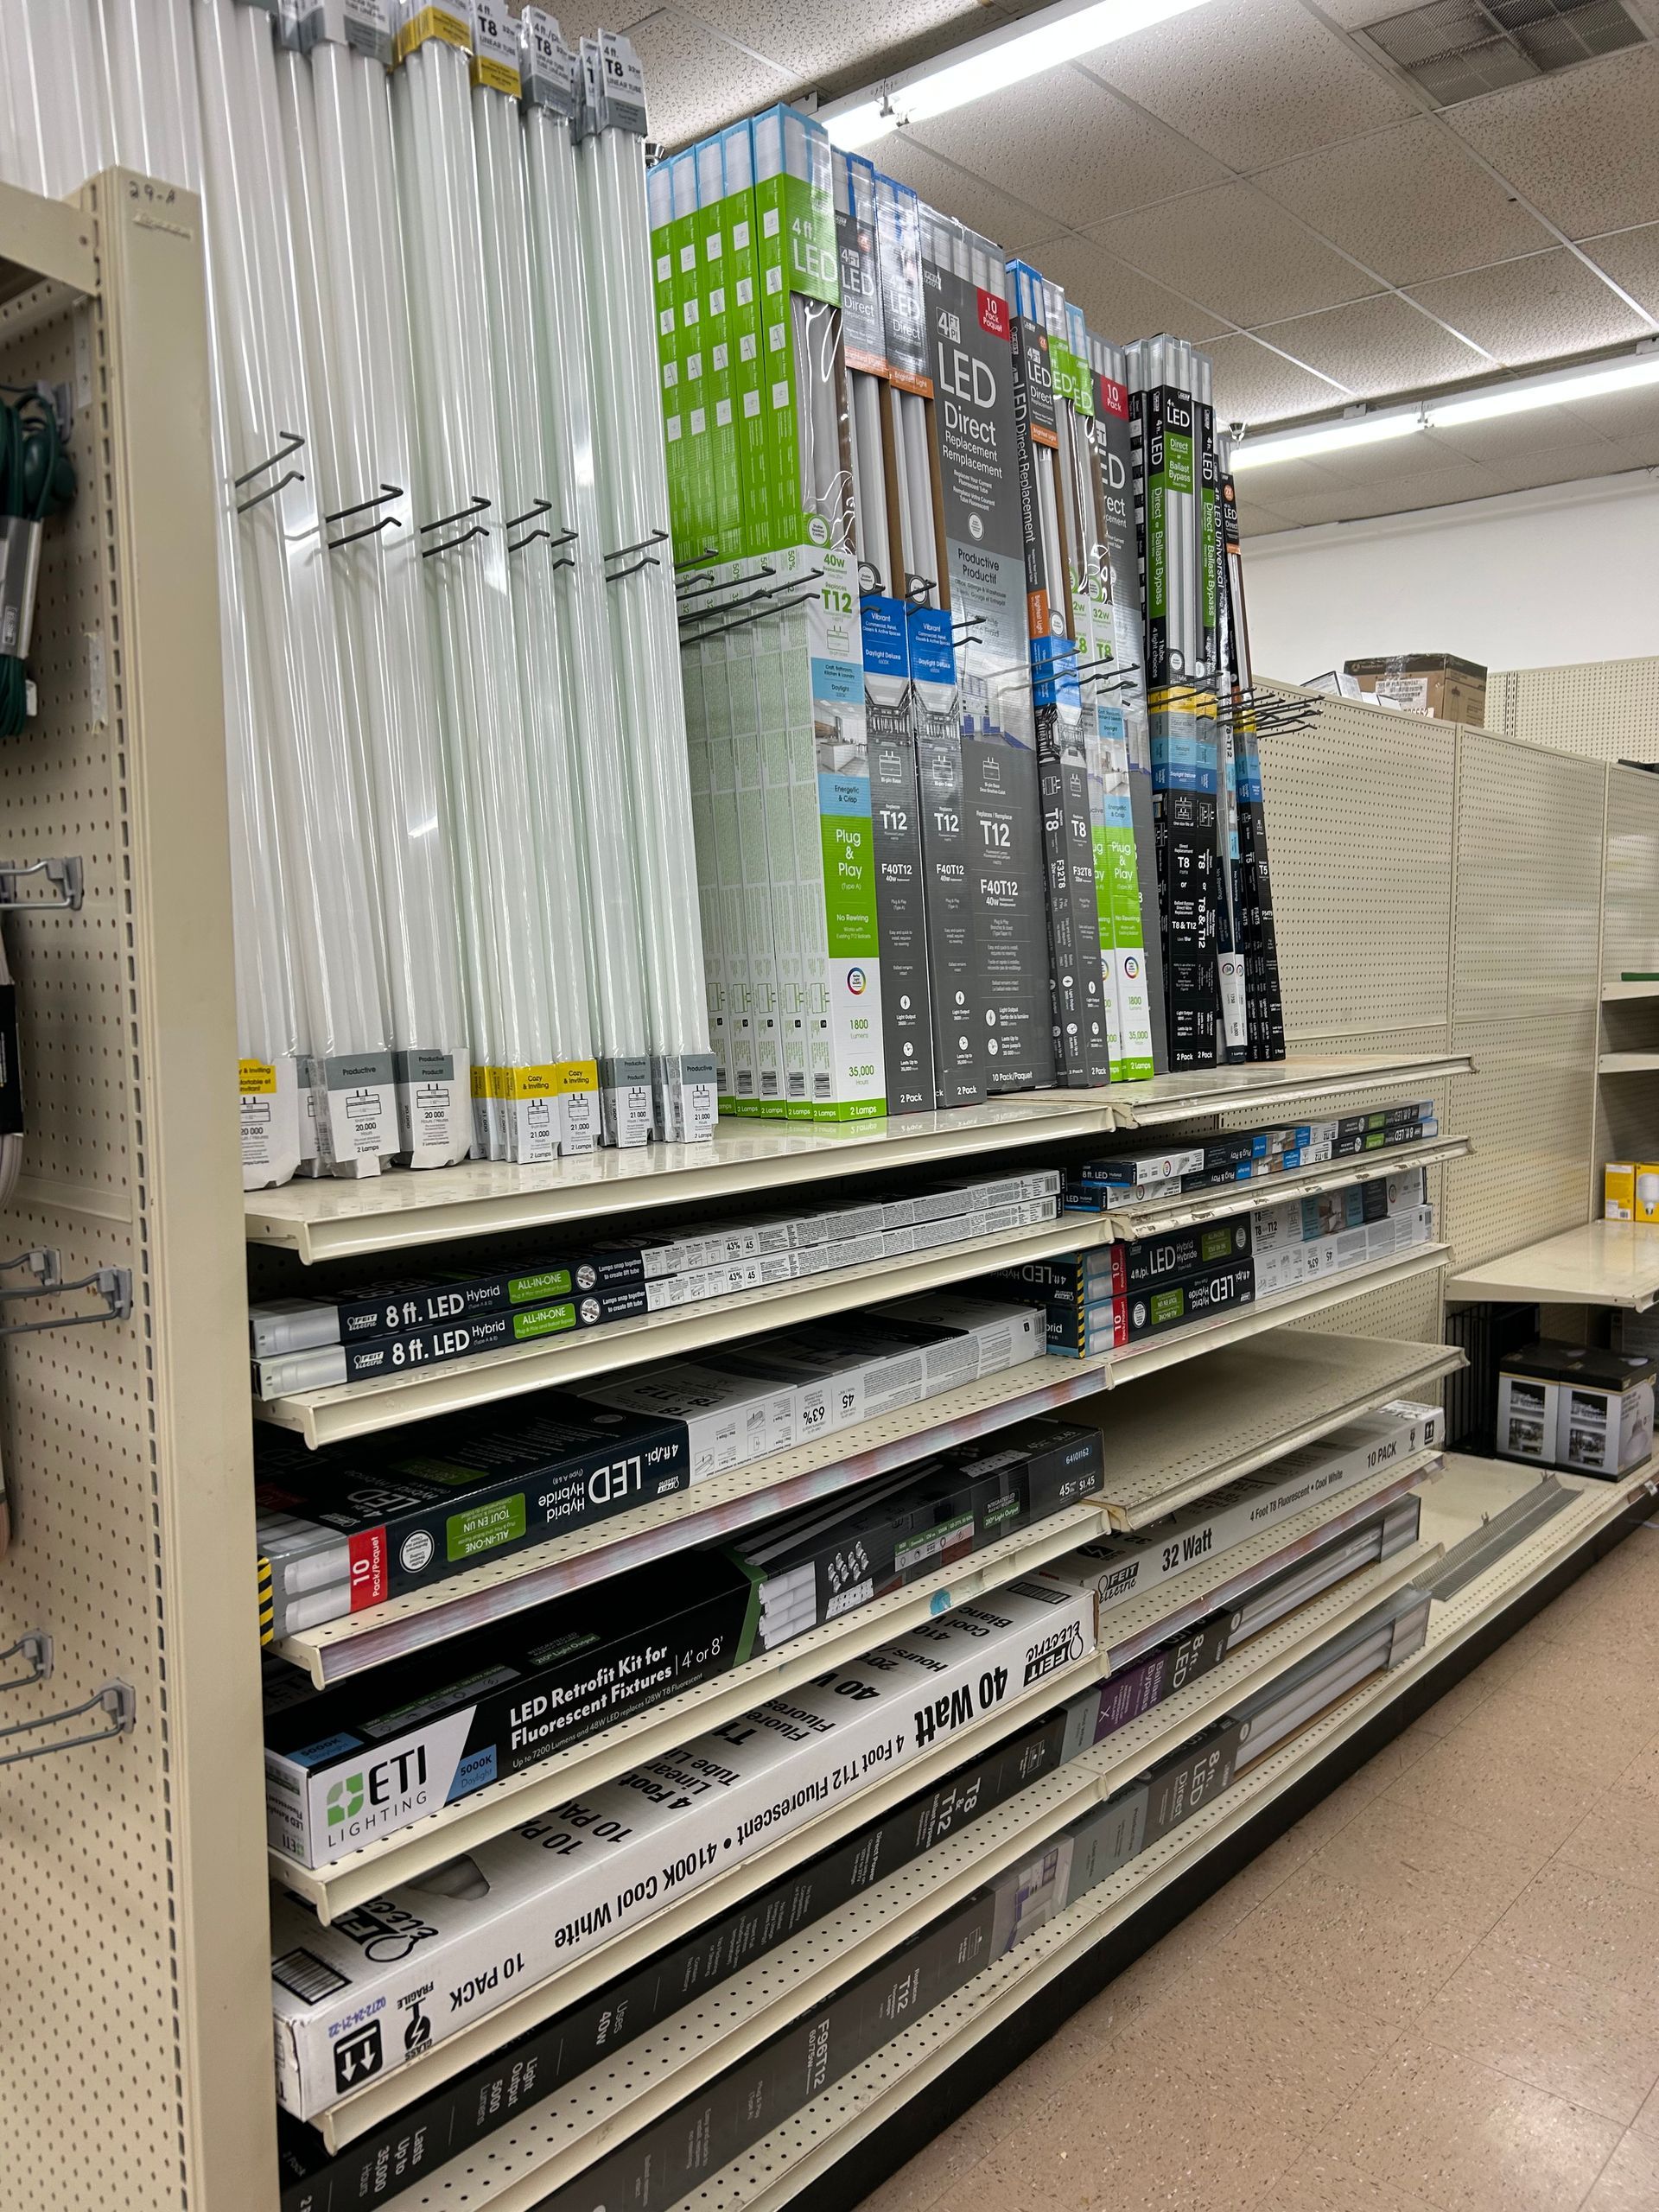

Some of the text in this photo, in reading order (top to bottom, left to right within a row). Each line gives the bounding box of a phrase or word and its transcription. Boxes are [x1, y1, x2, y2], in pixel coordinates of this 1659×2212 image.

[606, 59, 623, 77] T8
[793, 238, 838, 282] LED
[842, 265, 874, 297] LED
[844, 296, 875, 318] Direct
[986, 297, 997, 314] 10
[893, 318, 920, 340] Direct
[938, 341, 995, 409] LED
[1027, 361, 1052, 389] LED
[1107, 384, 1118, 401] 10
[1107, 397, 1122, 412] Pack
[944, 401, 996, 446] Direct
[1166, 407, 1190, 429] LED
[945, 430, 998, 462] Replacement
[943, 445, 1003, 479] Remplacement
[1013, 382, 1036, 543] LED Direct Replacement
[1169, 461, 1190, 474] Ballast
[1169, 470, 1191, 483] Bypass
[823, 553, 845, 568] 40w
[957, 548, 1000, 571] Productive
[1215, 531, 1224, 588] Universal
[963, 564, 997, 584] Productif
[821, 588, 852, 613] T12
[871, 612, 891, 622] Vibrant
[880, 810, 907, 830] T12
[934, 812, 959, 831] T12
[1045, 808, 1059, 831] T8
[1071, 820, 1087, 837] T8
[836, 830, 861, 847] Plug
[979, 820, 1011, 848] T12
[1111, 841, 1131, 855] Plug
[838, 862, 862, 879] Play
[881, 864, 912, 875] F40T12
[937, 864, 964, 875] F40T12
[1056, 859, 1066, 889] F32T8
[1072, 866, 1092, 876] F32T8
[1114, 868, 1134, 881] Play
[1177, 856, 1190, 868] T8
[980, 879, 1018, 896] F40T12
[849, 1019, 868, 1030] 1800
[1128, 1031, 1148, 1039] 35,000
[342, 1065, 376, 1076] Productive
[849, 1065, 874, 1077] 35,000
[999, 1071, 1033, 1081] Pack/Paquet
[528, 1081, 550, 1090] Inviting
[906, 1093, 922, 1103] Pack
[849, 1106, 877, 1116] 2 Lamps
[727, 1239, 753, 1252] 43% 45
[1177, 1251, 1198, 1262] Hybride
[518, 1274, 563, 1291] ALL-IN-ONE
[1211, 1274, 1234, 1302] LED
[385, 1285, 501, 1328] 8 ft. LED Hybrid
[522, 1307, 566, 1325] ALL-IN-ONE
[392, 1319, 506, 1365] 8 ft. LED Hybrid
[803, 1392, 855, 1427] 63% 45
[538, 1481, 585, 1507] Hybride
[546, 1444, 679, 1523] 4 ft./pi. LED Hybrid
[1079, 1476, 1096, 1491] $1.45
[1161, 1440, 1397, 1573] 32 Watt 4 Foot T8 Fluorescent Cool White 10 PACK
[465, 1529, 509, 1554] ALL-IN-ONE
[353, 1559, 370, 1586] 10
[372, 1535, 380, 1597] Pack/Paquet
[1107, 1561, 1140, 1592] FEIT
[958, 1606, 1014, 1629] Blanc
[1192, 1633, 1205, 1651] 8
[1025, 1641, 1070, 1687] FEIT
[1173, 1639, 1192, 1688] LED
[510, 1644, 668, 1728] LED Retrofit Kit for
[511, 1694, 607, 1751] Fluorescent
[610, 1664, 672, 1703] Fixtures
[696, 1648, 709, 1663] or
[512, 1673, 702, 1769] Up to 7200 Lumens and 48W LED replaces 128W T8 Fluorescent
[368, 1745, 427, 1806] ETI
[460, 1754, 493, 1777] 5000K
[461, 1768, 493, 1789] Daylight
[618, 1771, 693, 1810] 4 Foot
[1173, 1770, 1188, 1819] Direct
[1190, 1758, 1207, 1805] LED
[554, 1666, 1008, 1948] 40 Watt 4 Foot T12 Fluorescent 4100K Cool White
[963, 1777, 982, 1813] T8
[327, 1789, 428, 1847] LIGHTING
[937, 1788, 957, 1835] T12
[449, 1952, 525, 2012] 10 PACK
[897, 1974, 912, 2013] T12
[397, 1980, 435, 2011] FRAGILE
[596, 2011, 613, 2045] 40w
[613, 1999, 630, 2035] Uses
[813, 2018, 830, 2089] F96T12
[507, 2062, 524, 2107] Output
[523, 2056, 538, 2093] Light
[476, 2082, 488, 2126] Lumens
[489, 2079, 504, 2113] 5000
[395, 2135, 410, 2177] Up to
[412, 2126, 429, 2165] Lasts
[373, 2145, 391, 2194] 35,000
